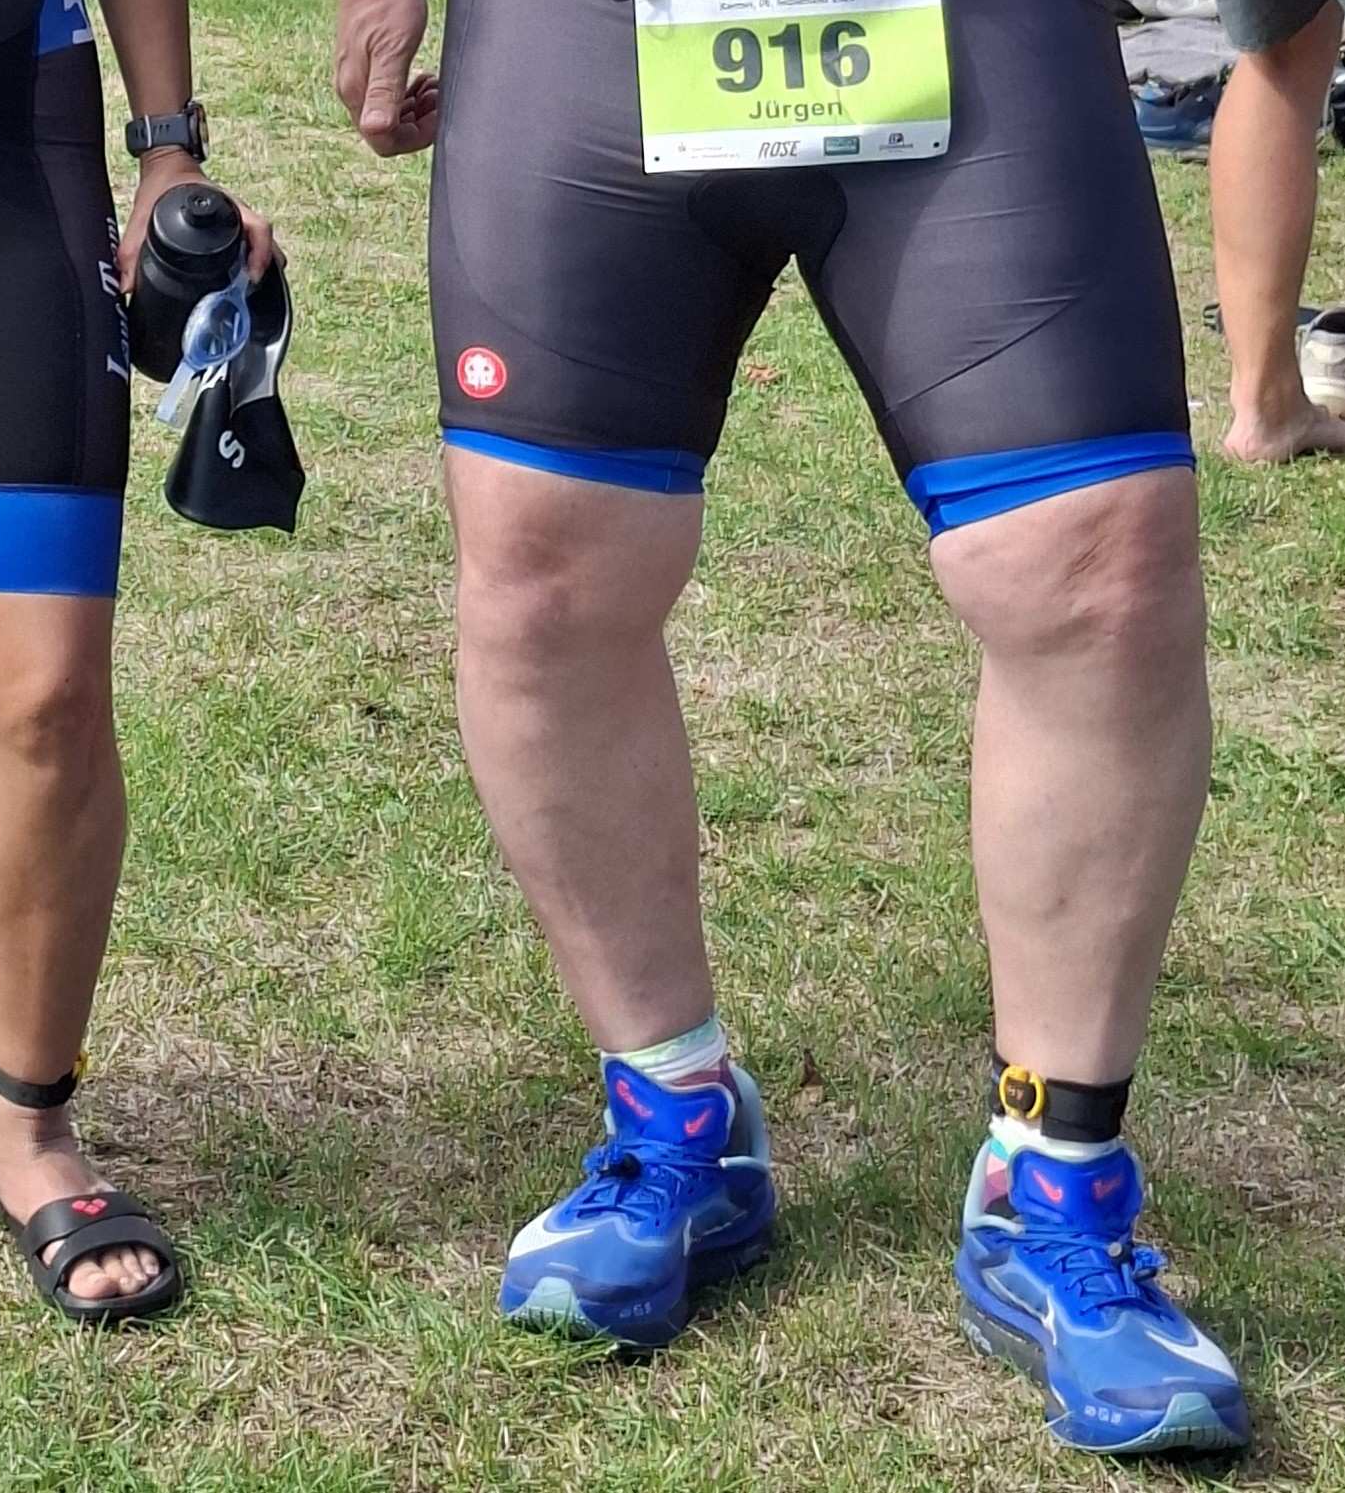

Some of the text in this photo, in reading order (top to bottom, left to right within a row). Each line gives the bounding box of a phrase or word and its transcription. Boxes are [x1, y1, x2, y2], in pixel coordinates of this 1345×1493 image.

[712, 20, 872, 94] 916
[748, 98, 844, 123] Jürgen
[759, 139, 801, 159] ROSE
